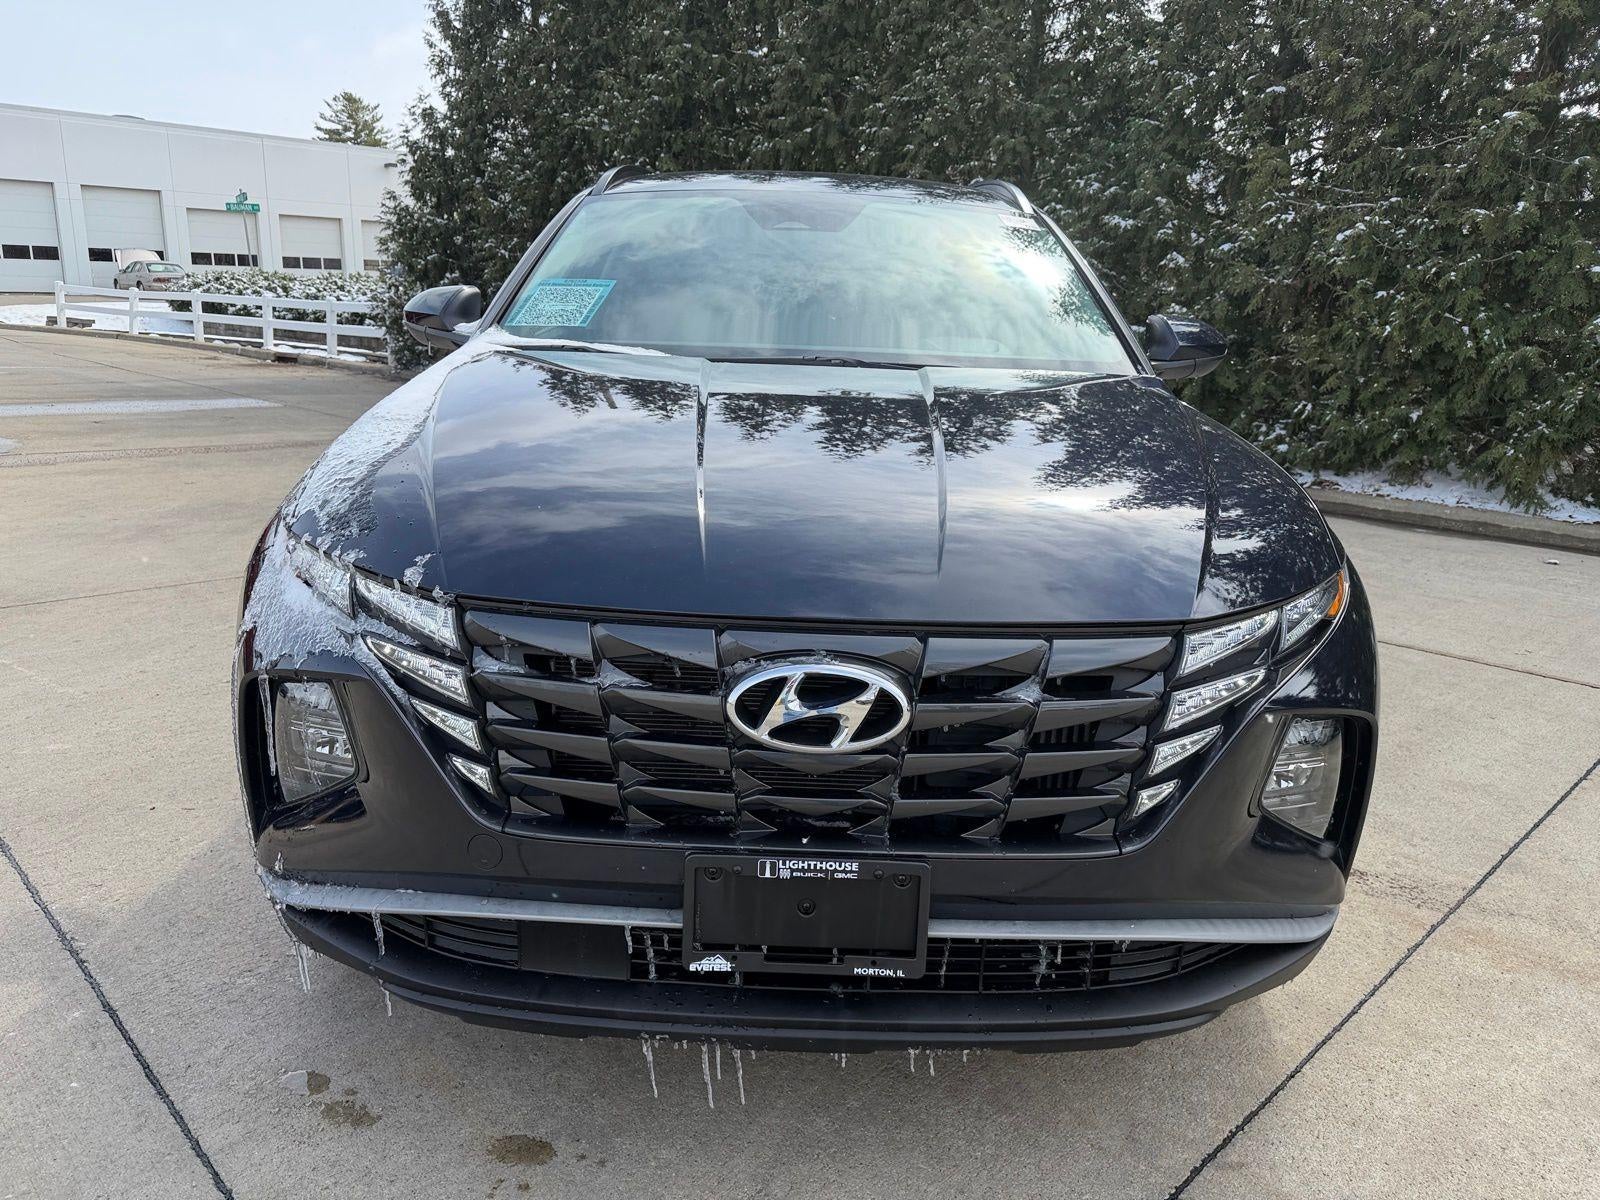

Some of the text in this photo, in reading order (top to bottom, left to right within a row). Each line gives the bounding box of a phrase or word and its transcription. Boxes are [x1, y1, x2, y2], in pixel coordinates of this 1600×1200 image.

[778, 860, 859, 871] LIGHTHOUSE
[689, 962, 732, 972] everest
[853, 967, 905, 978] MORTON, IL
